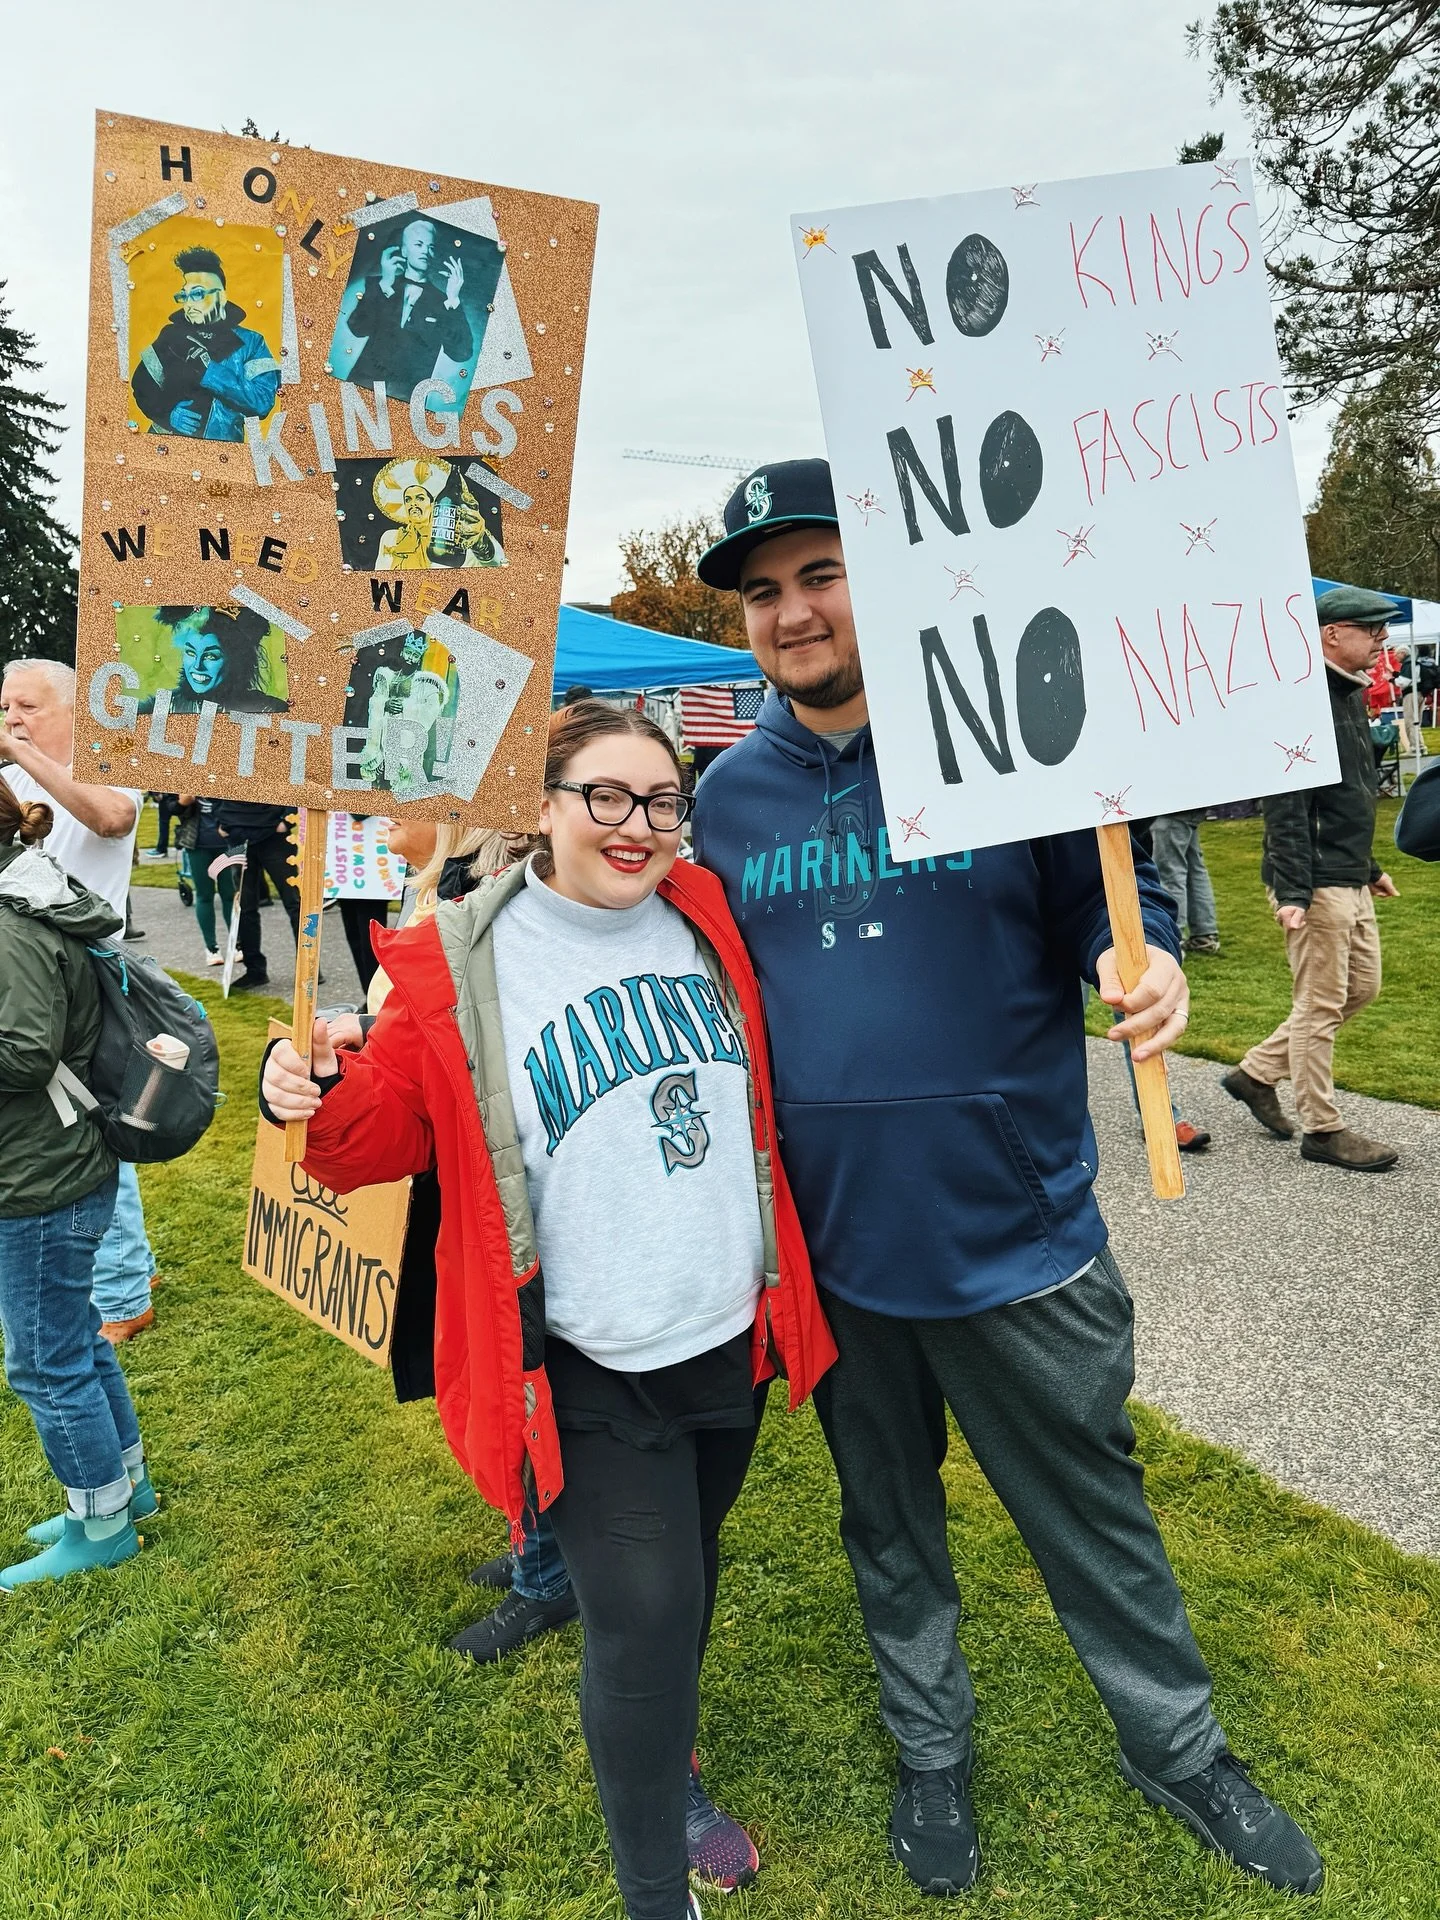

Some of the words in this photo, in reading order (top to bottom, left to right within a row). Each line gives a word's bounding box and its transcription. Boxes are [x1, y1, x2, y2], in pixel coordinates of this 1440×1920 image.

[243, 167, 352, 279] ONLY
[852, 233, 1009, 349] NO
[1070, 203, 1251, 308] KINGS
[244, 378, 523, 486] KINGS
[886, 410, 1043, 546] NO
[1073, 382, 1279, 506] FASCISTS
[101, 524, 176, 562] WE
[199, 527, 319, 584] NEED
[370, 578, 503, 629] WEAR
[918, 606, 1087, 785] NO
[1115, 594, 1312, 732] NAZIS
[335, 813, 347, 840] THE
[335, 846, 348, 885] OUST
[745, 815, 855, 850] SEAT
[741, 878, 974, 920] BASEBALL
[524, 973, 748, 1157] MARINE
[247, 1186, 395, 1350] IMMIGRANTS
